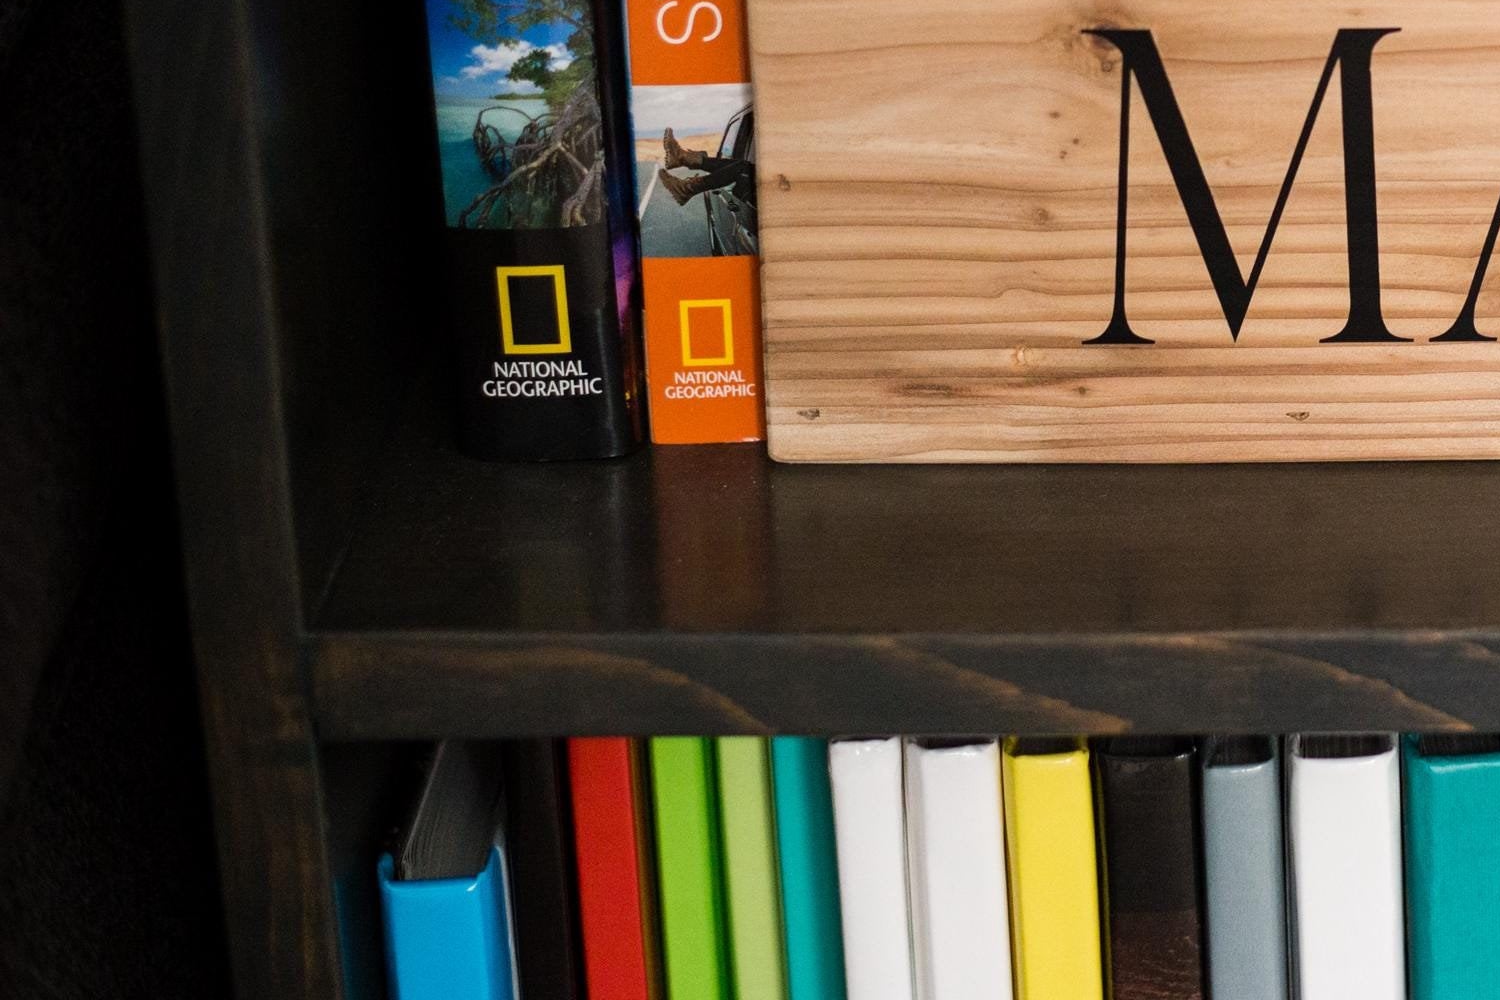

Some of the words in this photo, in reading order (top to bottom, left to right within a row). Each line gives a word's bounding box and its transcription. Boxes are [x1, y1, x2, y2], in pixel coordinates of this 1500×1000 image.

[493, 360, 588, 379] NATIONAL
[674, 370, 746, 384] NATIONAL
[483, 377, 603, 397] GEOGRAPHIC
[664, 383, 756, 399] GEOGRAPHIC
